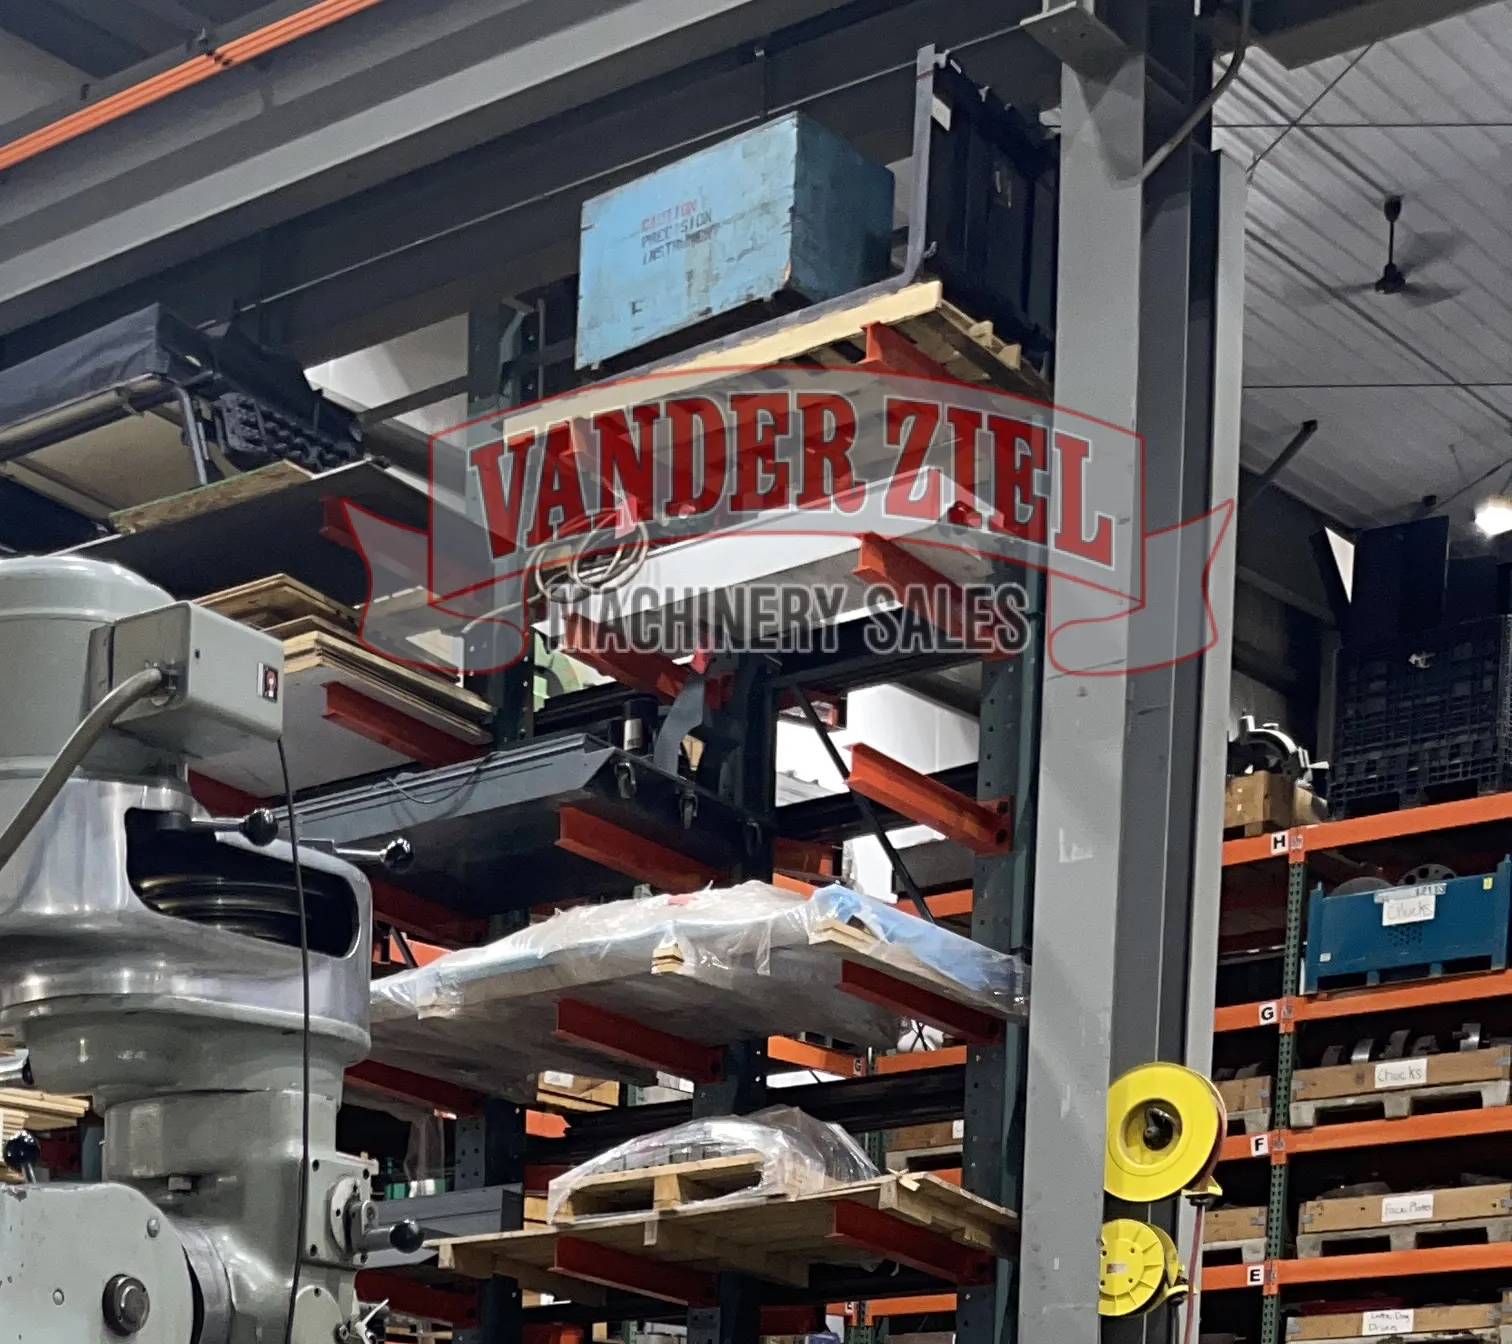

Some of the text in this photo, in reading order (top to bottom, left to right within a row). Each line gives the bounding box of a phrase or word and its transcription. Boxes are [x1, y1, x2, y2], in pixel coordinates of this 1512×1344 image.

[1273, 835, 1286, 849] H
[1261, 1006, 1274, 1021] G
[1255, 1138, 1264, 1151] F
[1249, 1269, 1260, 1282] E
